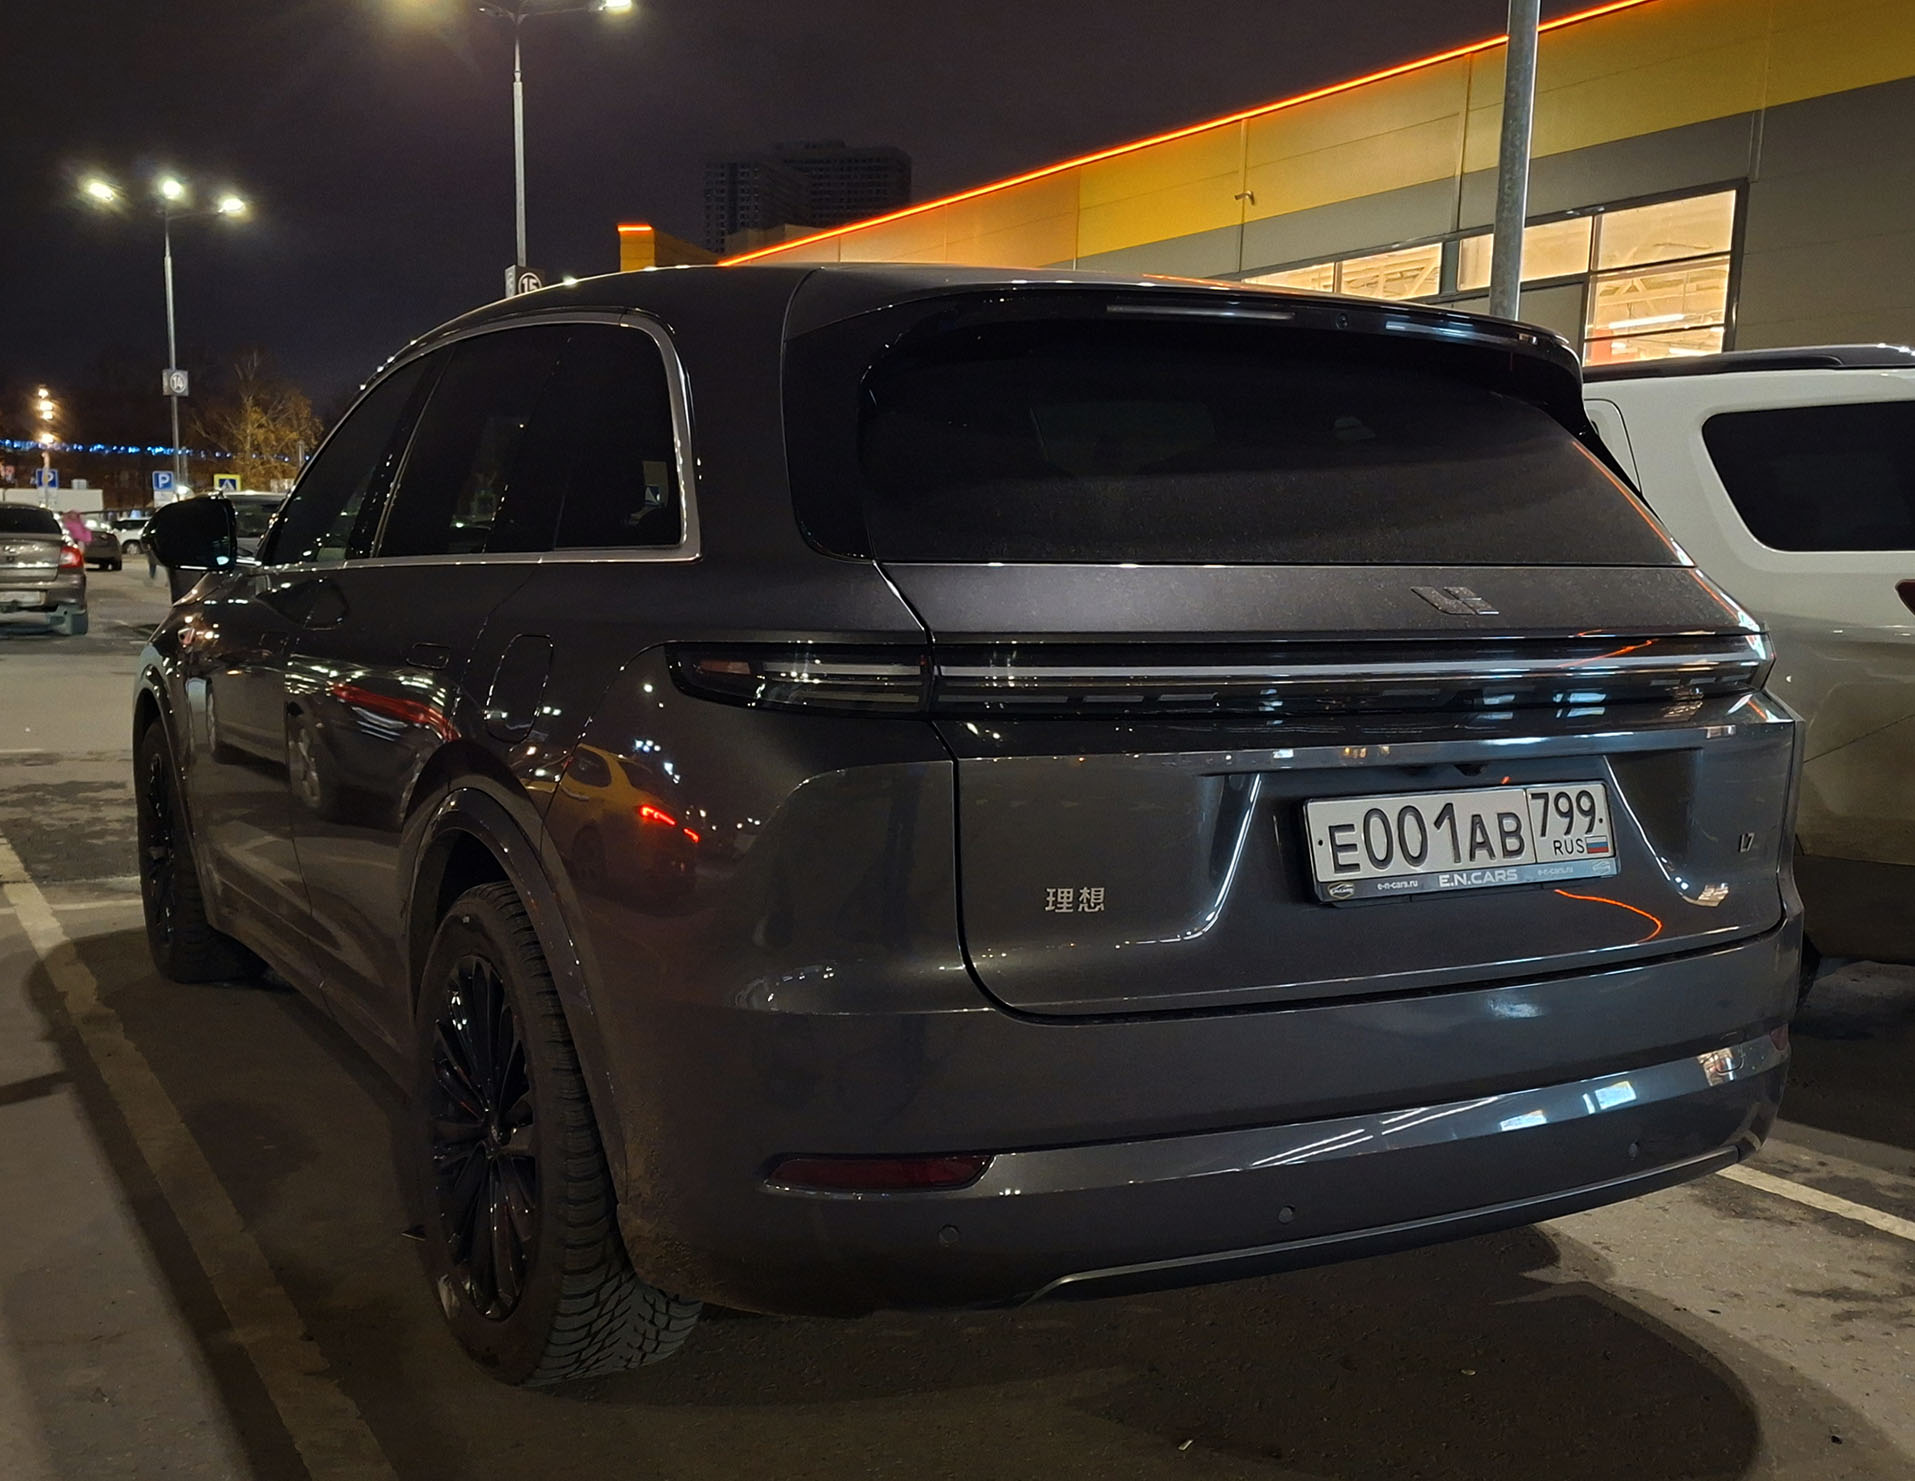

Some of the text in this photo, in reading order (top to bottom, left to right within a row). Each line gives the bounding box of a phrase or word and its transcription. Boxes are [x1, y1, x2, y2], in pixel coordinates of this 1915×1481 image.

[172, 375, 184, 389] 14
[159, 474, 170, 488] P
[1530, 790, 1597, 838] 799
[1328, 802, 1525, 874] E001AB
[1553, 839, 1585, 856] RUS
[1377, 879, 1419, 891] e-n-cars.ru
[1438, 869, 1518, 888] E.N.CARS
[1045, 887, 1105, 913] 理想
